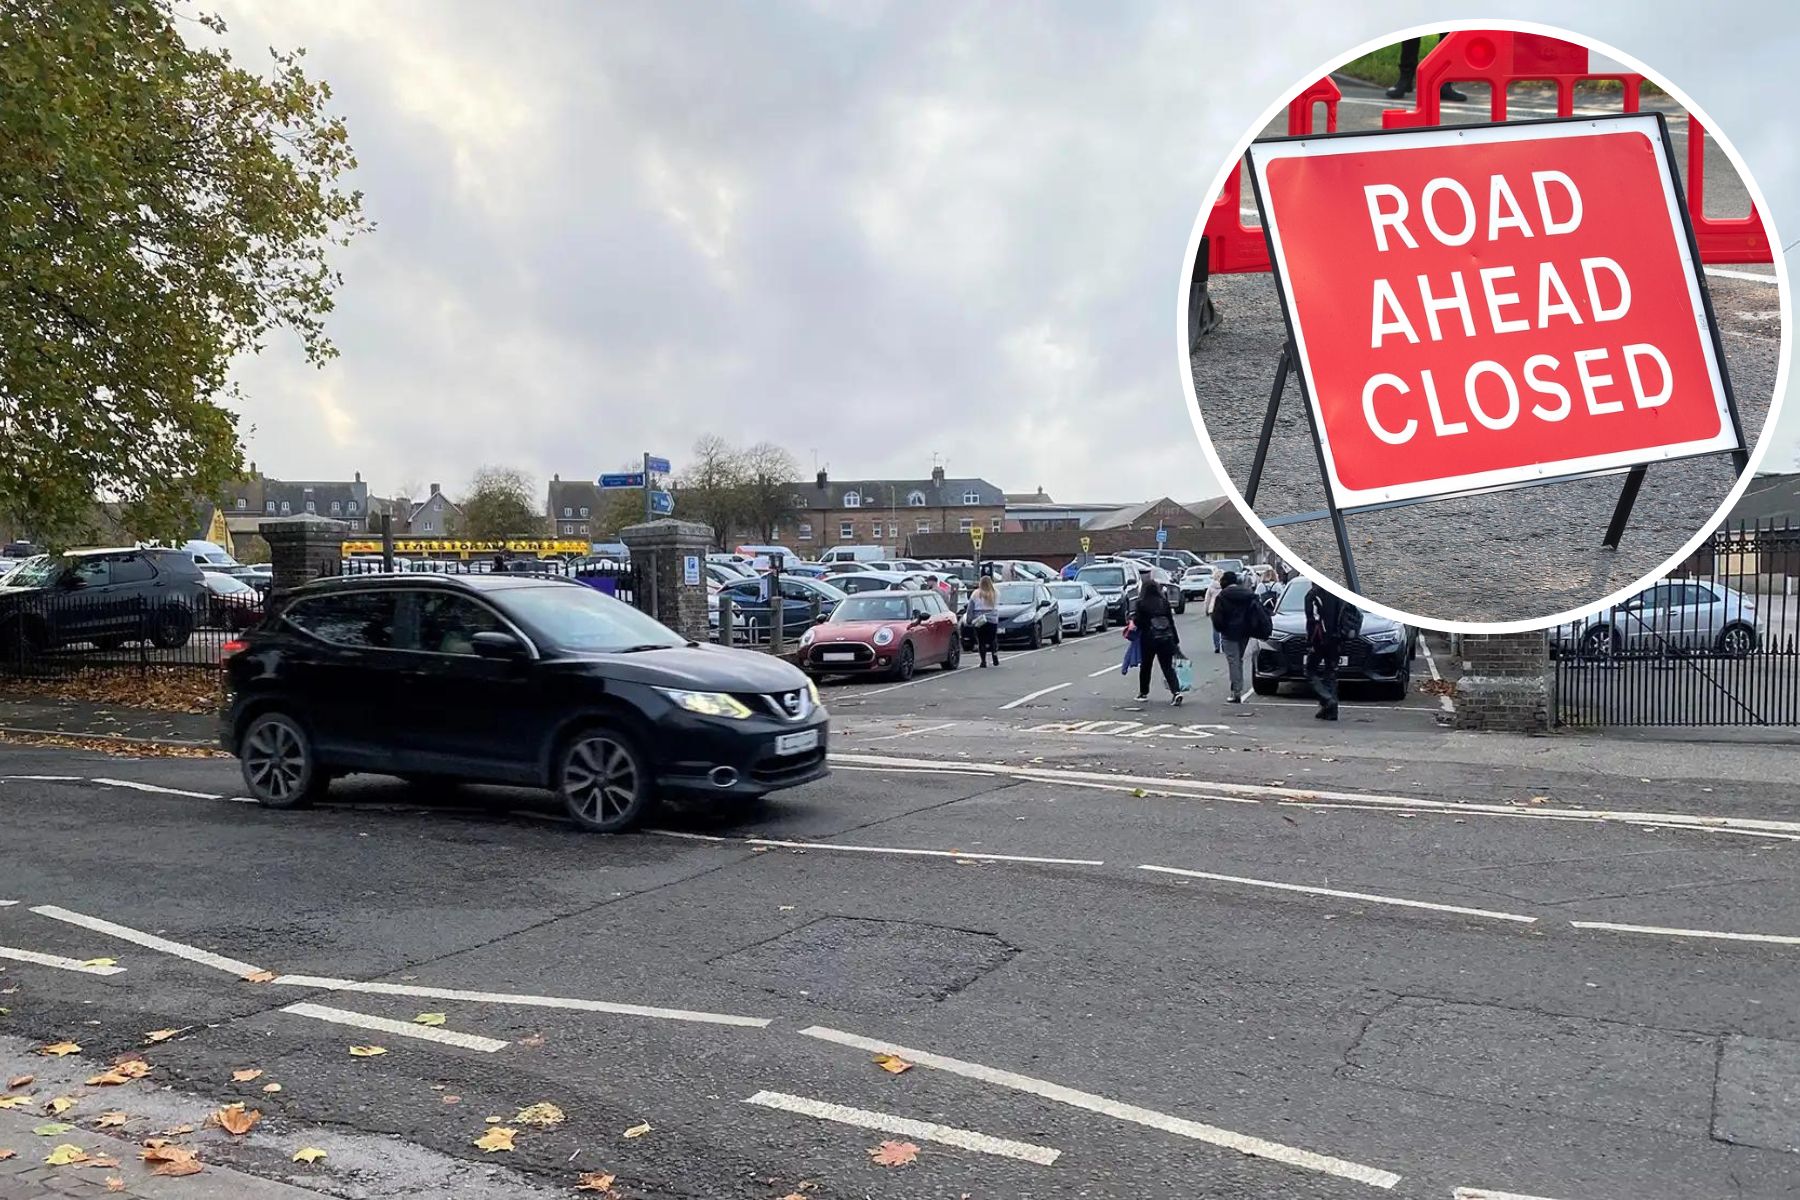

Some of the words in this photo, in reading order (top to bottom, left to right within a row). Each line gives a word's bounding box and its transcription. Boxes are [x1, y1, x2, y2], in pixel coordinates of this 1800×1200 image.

[1364, 170, 1583, 252] ROAD
[1371, 257, 1632, 349] AHEAD
[1361, 342, 1674, 445] CLOSED
[1019, 720, 1231, 738] STOP
